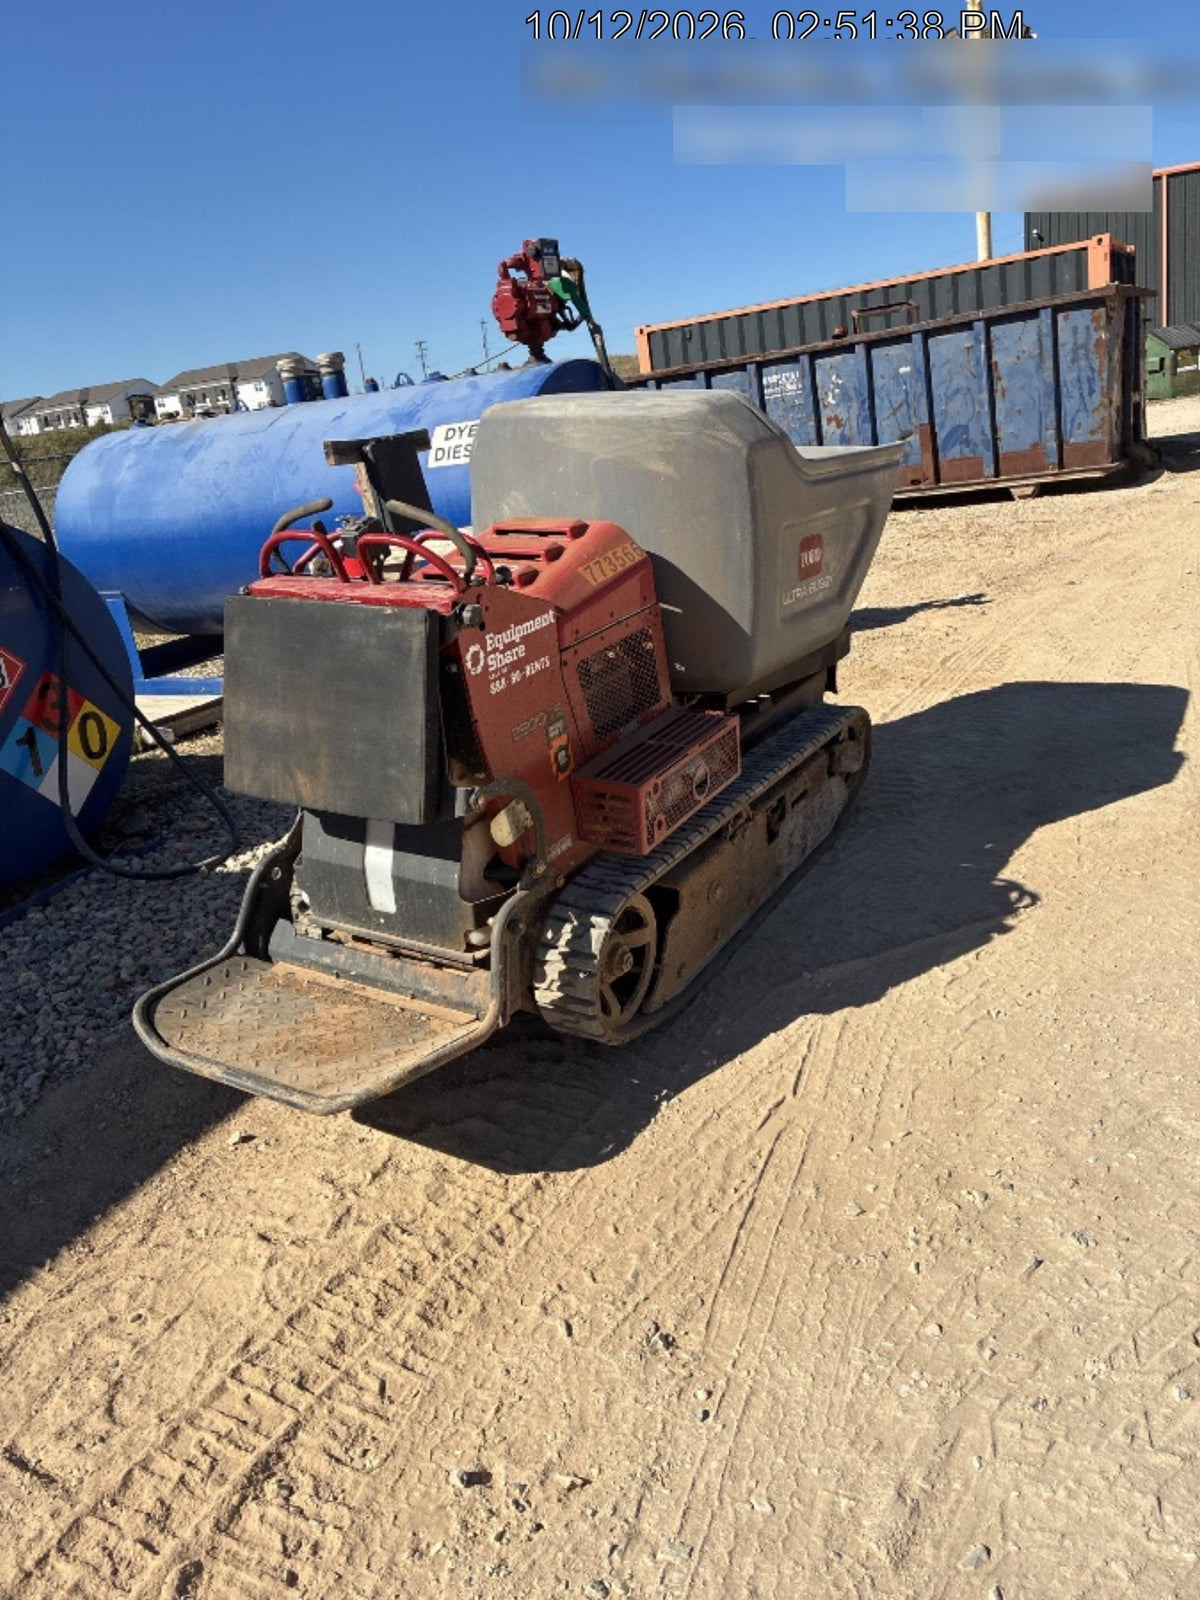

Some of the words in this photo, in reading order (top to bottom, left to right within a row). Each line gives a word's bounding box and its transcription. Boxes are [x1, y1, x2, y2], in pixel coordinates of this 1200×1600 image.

[485, 609, 555, 652] Equipment
[487, 644, 526, 672] Share
[16, 726, 43, 777] 1
[77, 710, 108, 760] 0
